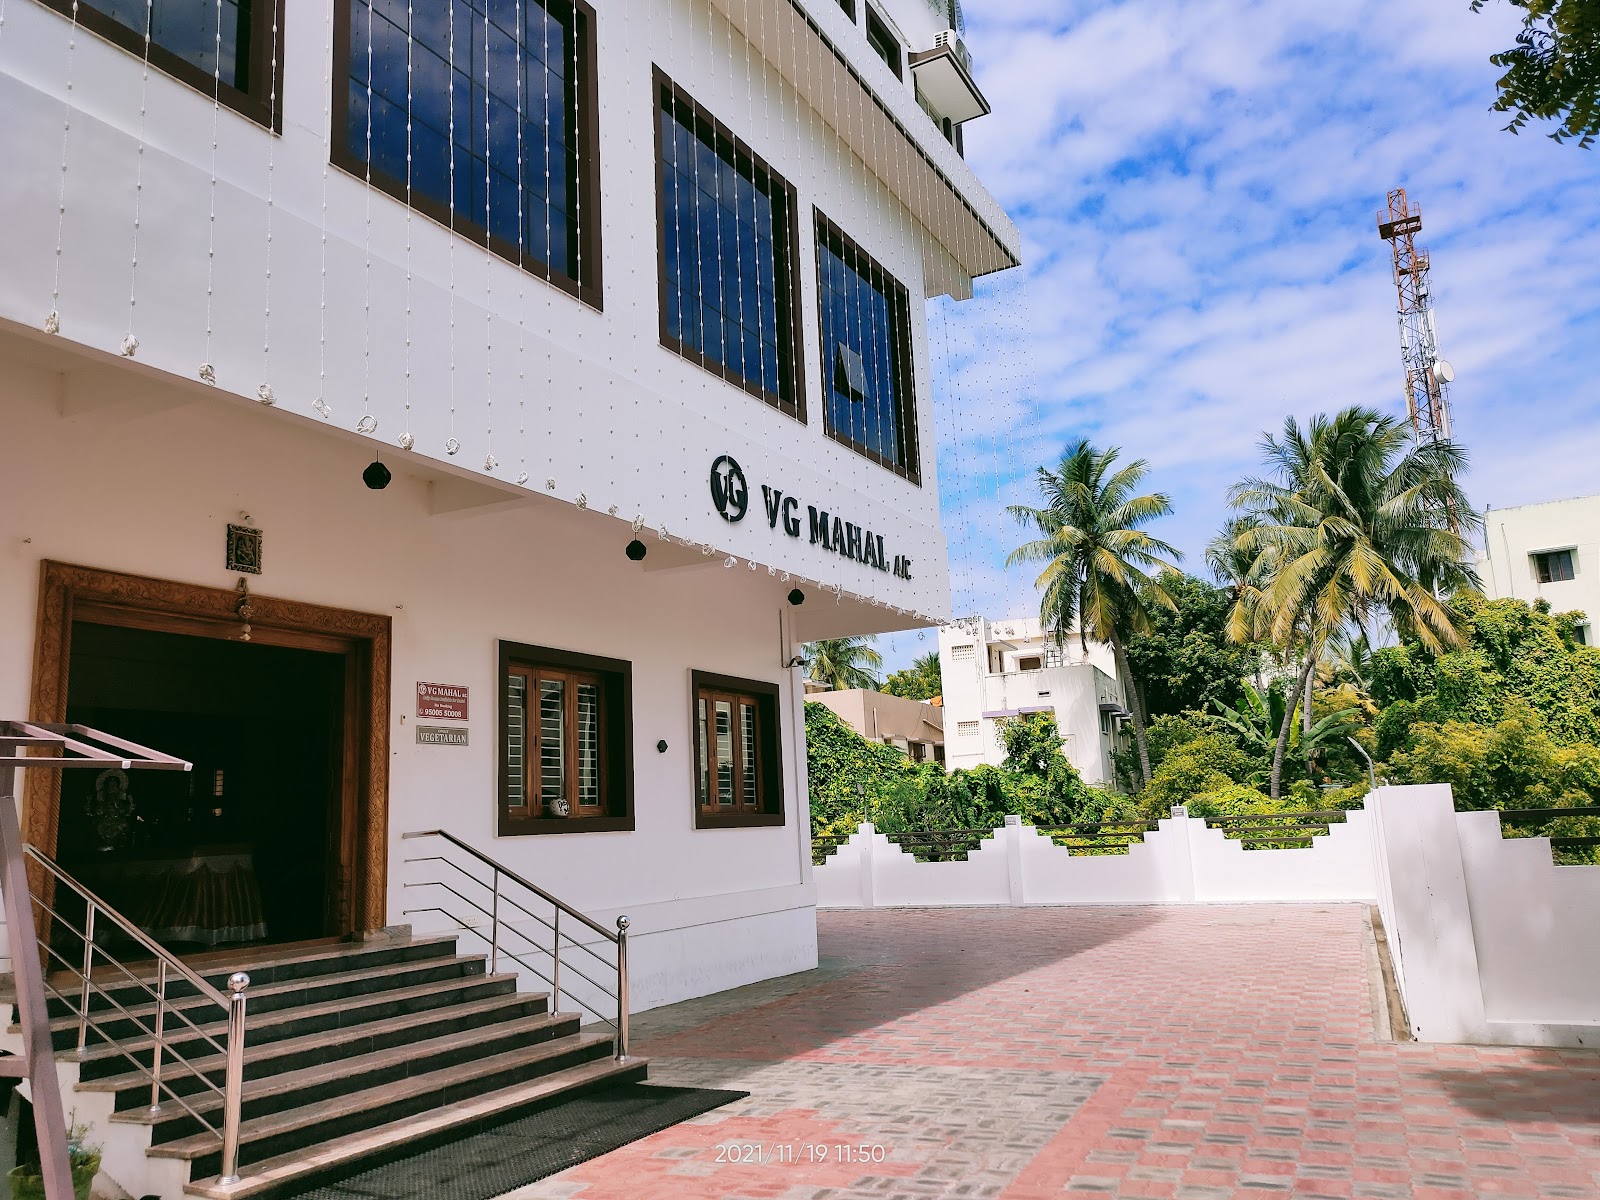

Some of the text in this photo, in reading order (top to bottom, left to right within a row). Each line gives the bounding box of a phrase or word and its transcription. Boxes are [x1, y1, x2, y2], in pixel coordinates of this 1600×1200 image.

[710, 462, 748, 518] VG
[761, 484, 801, 537] VG
[807, 505, 890, 572] MAHAL
[427, 686, 437, 695] VG
[438, 688, 461, 697] MAHAL
[420, 733, 466, 742] VEGETARIAN
